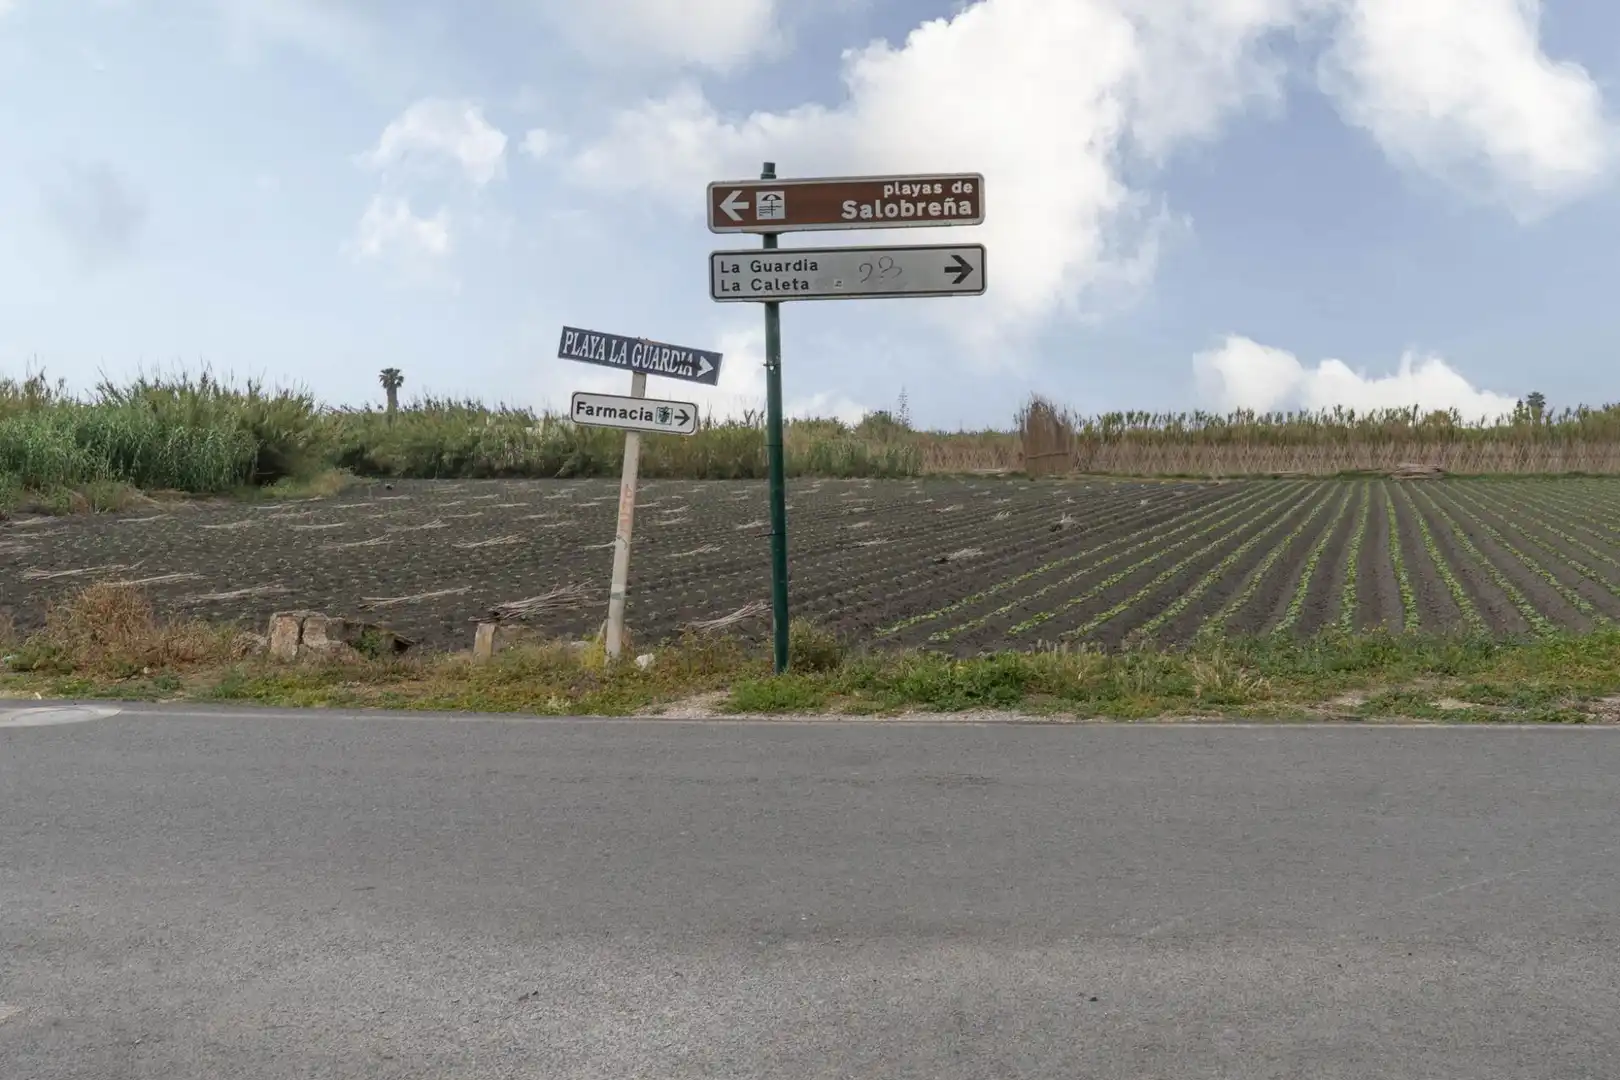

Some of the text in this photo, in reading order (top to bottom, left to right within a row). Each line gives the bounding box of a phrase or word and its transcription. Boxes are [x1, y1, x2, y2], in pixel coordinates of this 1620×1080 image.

[883, 180, 973, 198] playas de
[841, 198, 972, 220] Salobreña
[721, 258, 818, 274] La Guardia
[721, 276, 809, 292] La Caleta
[563, 331, 693, 376] PLAYA LA GUARDIA
[576, 401, 653, 422] Farmacia
